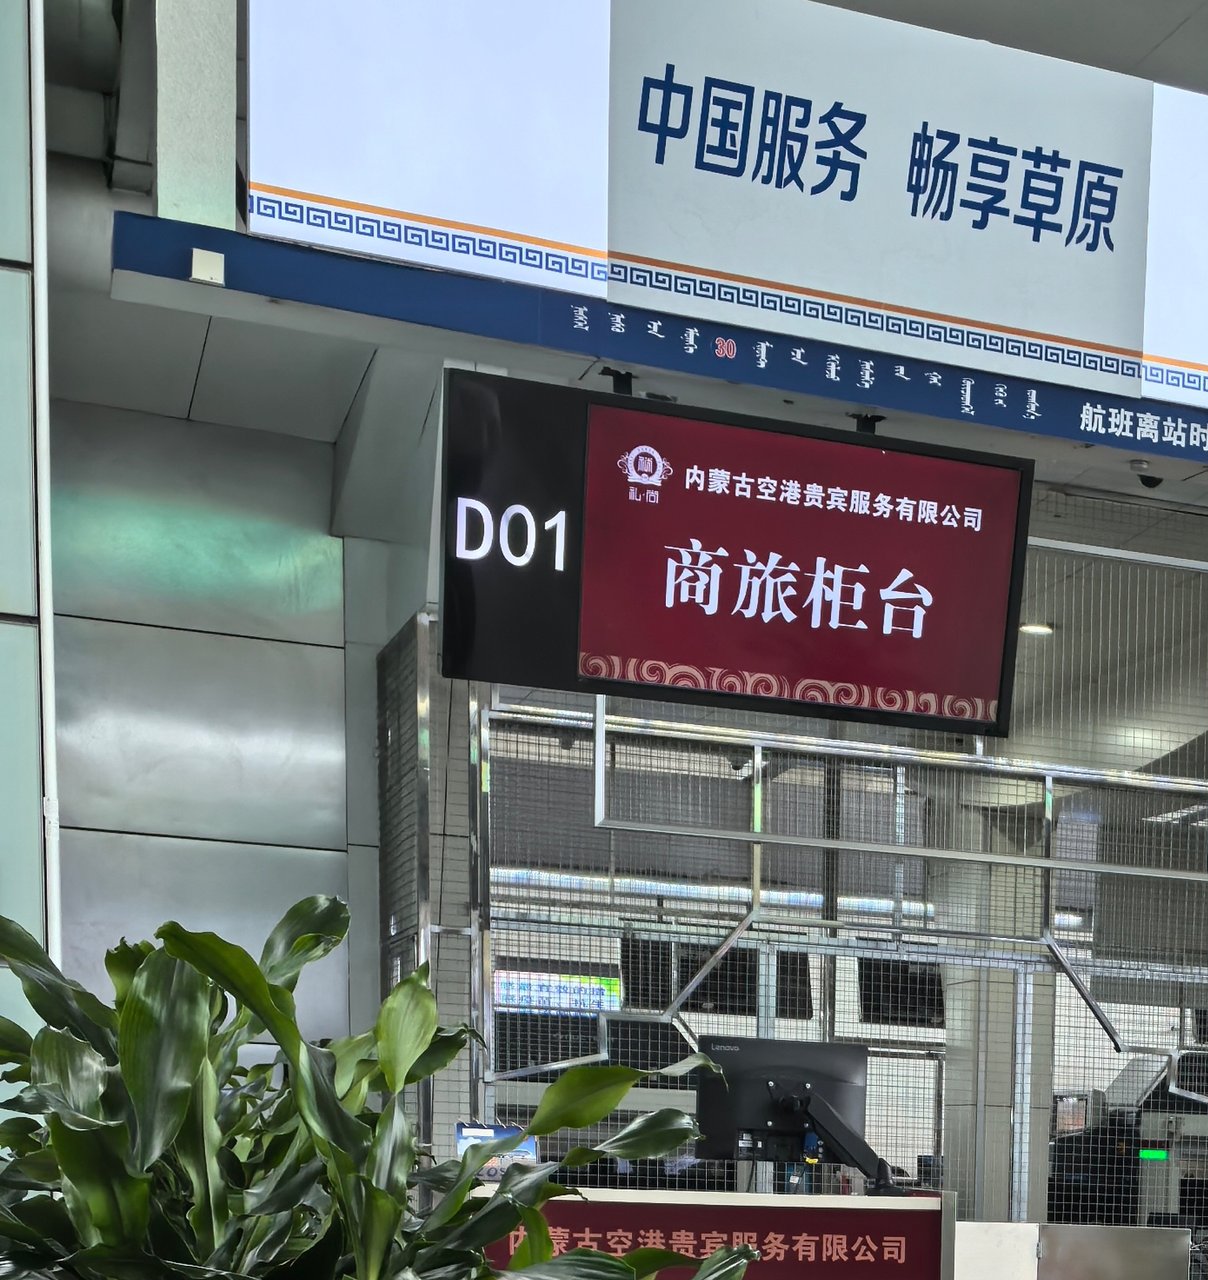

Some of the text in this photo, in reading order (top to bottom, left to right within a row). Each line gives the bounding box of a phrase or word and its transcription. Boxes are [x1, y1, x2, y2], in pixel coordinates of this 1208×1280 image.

[637, 63, 1124, 253] 中国服务 畅享草原
[715, 337, 737, 359] 30
[685, 466, 983, 532] 内蒙古空港贵宾服务有限公司
[455, 497, 567, 572] D01
[663, 539, 933, 639] 商旅柜台
[711, 1043, 739, 1051] Lenovo
